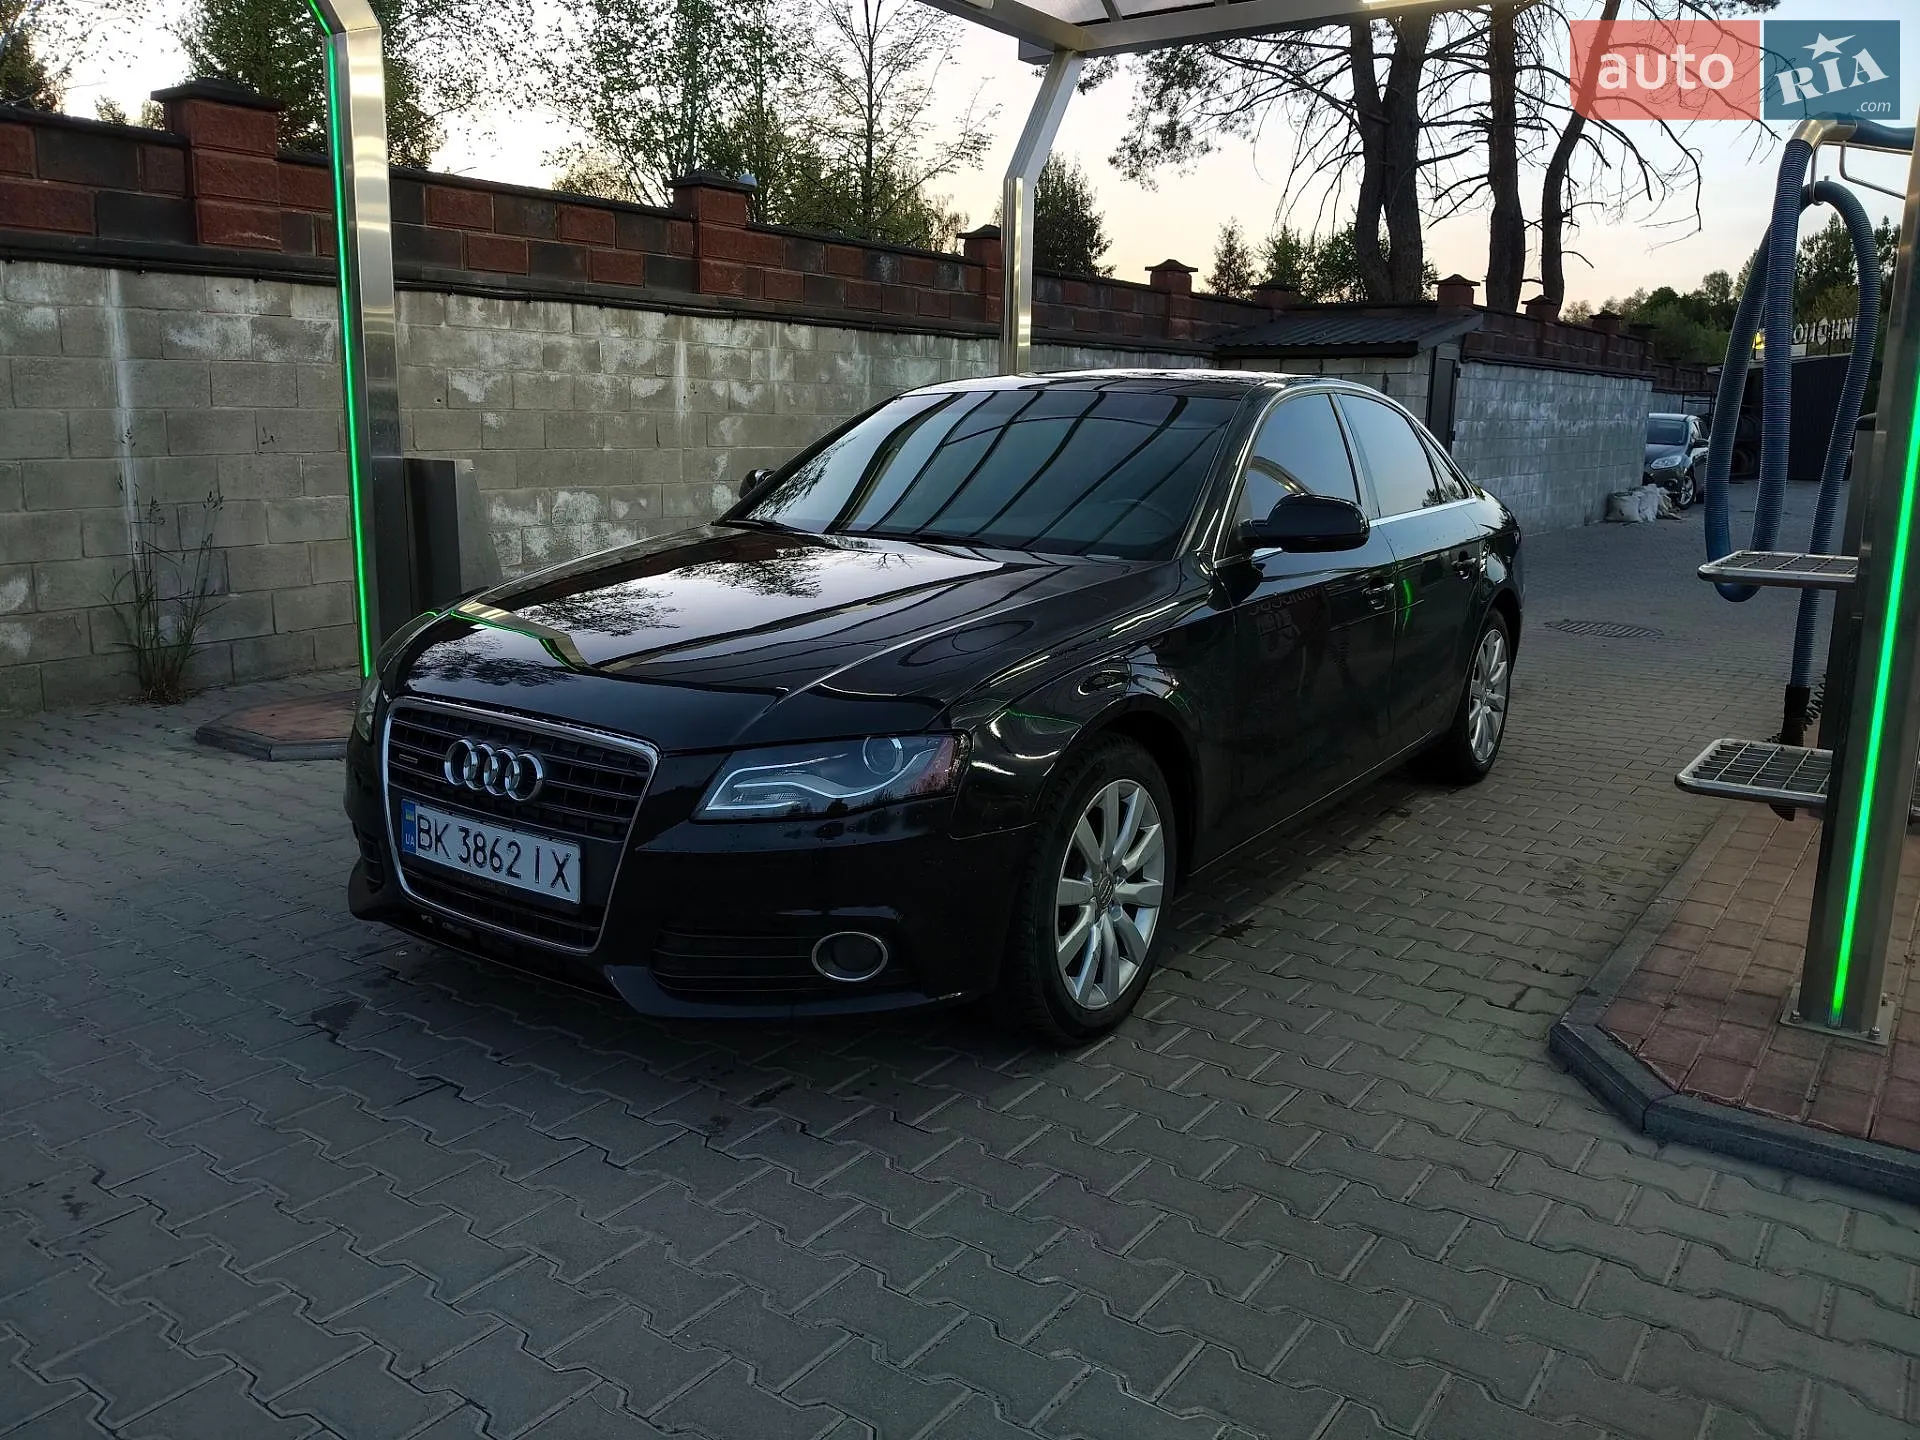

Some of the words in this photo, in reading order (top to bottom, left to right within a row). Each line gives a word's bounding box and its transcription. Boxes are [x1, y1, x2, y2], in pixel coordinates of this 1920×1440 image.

[405, 832, 415, 847] UA
[417, 813, 451, 860] BK
[457, 825, 522, 879] 3862
[534, 845, 572, 892] IX
